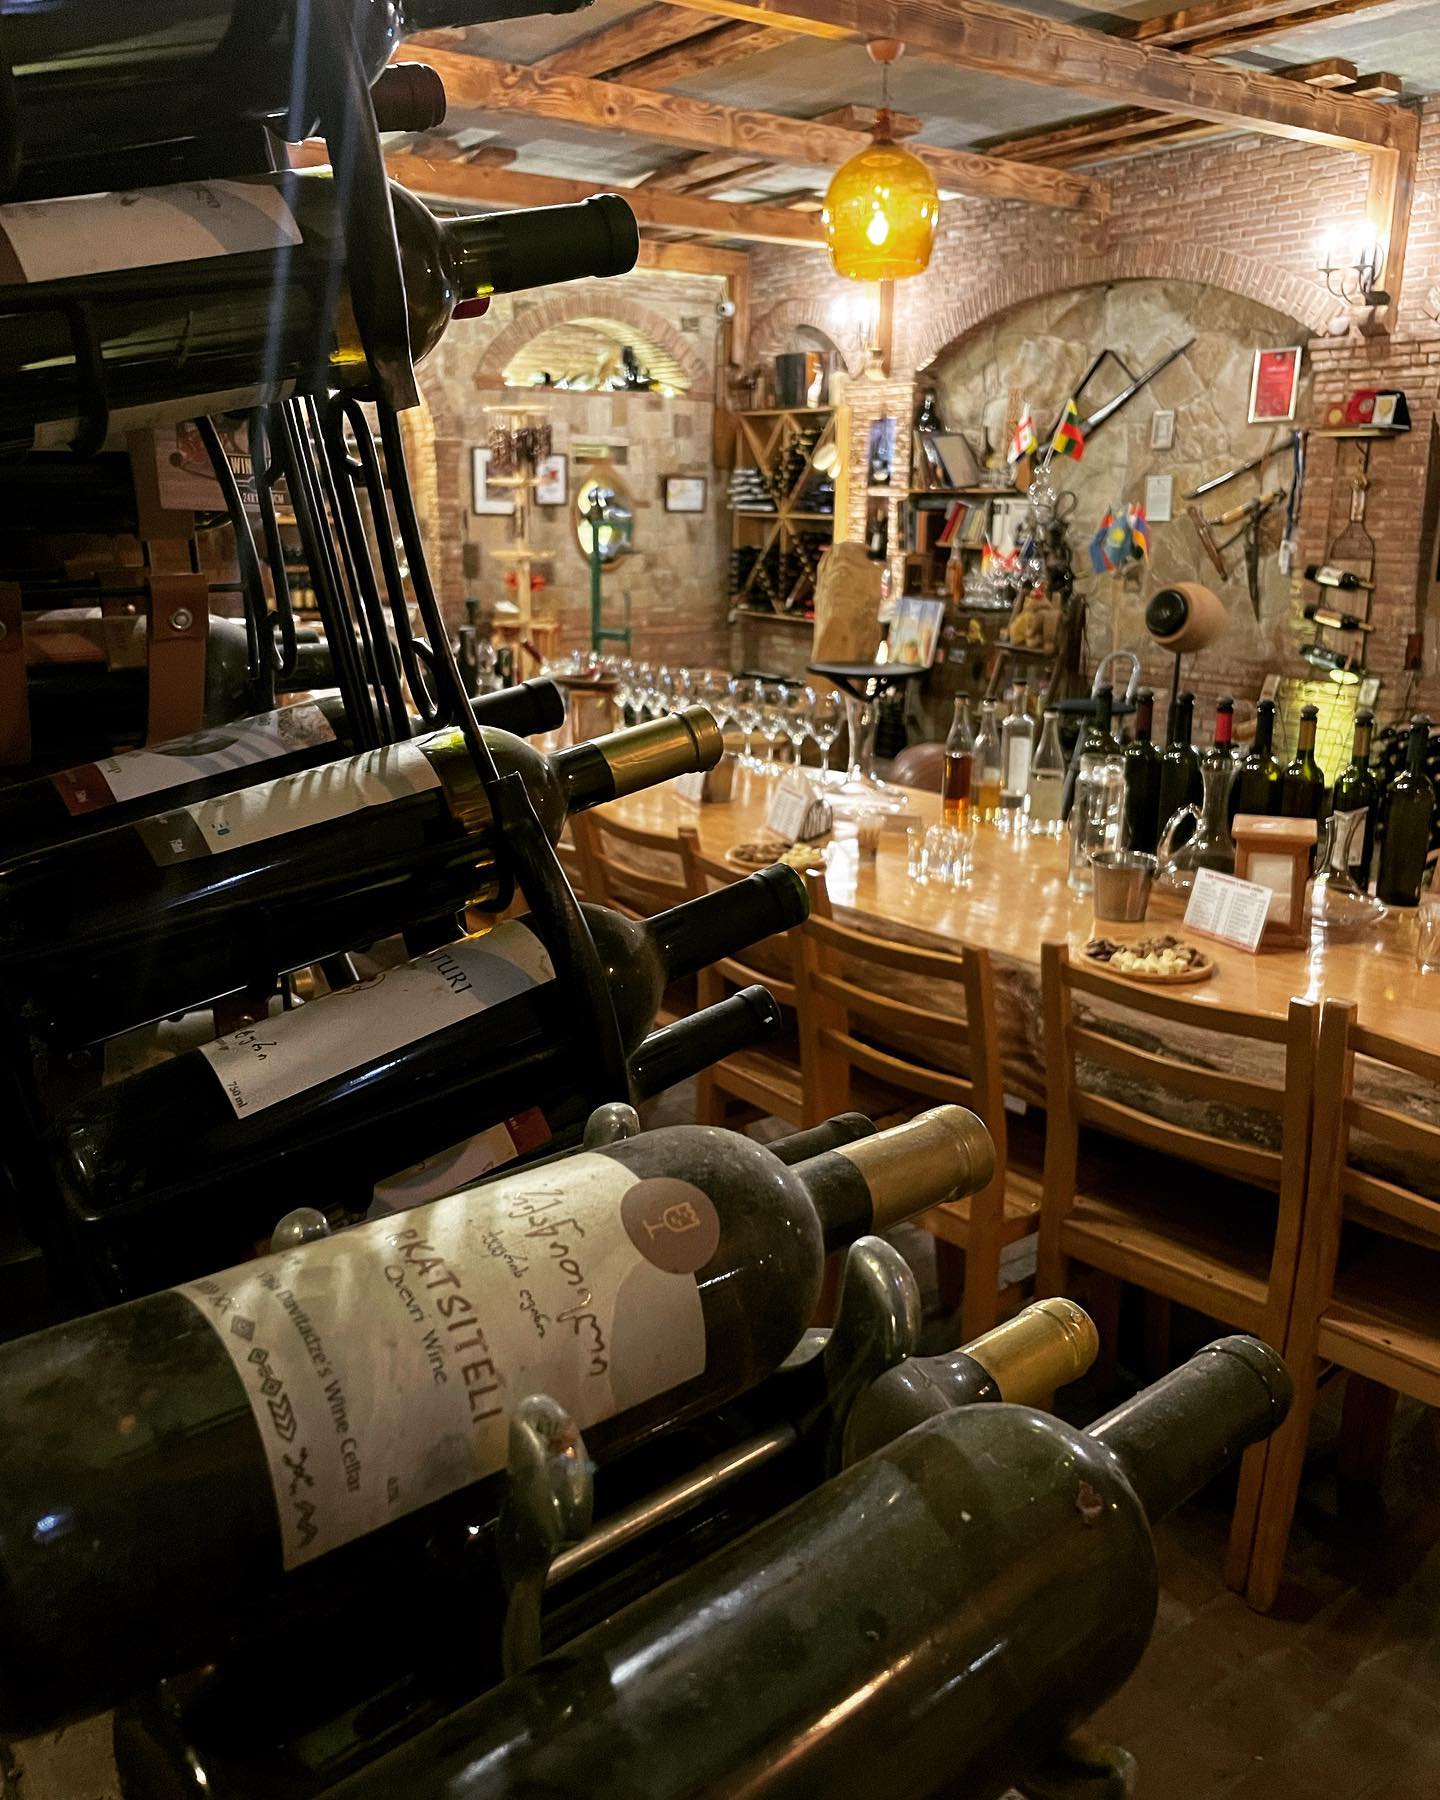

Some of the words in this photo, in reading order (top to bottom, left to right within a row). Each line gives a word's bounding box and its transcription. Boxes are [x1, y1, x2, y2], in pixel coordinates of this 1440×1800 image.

[229, 457, 252, 475] WIN
[429, 952, 473, 994] TURI
[384, 1263, 425, 1323] Qvevri
[421, 1328, 449, 1386] Wine
[323, 1379, 351, 1435] Wine
[339, 1437, 361, 1494] Cellar
